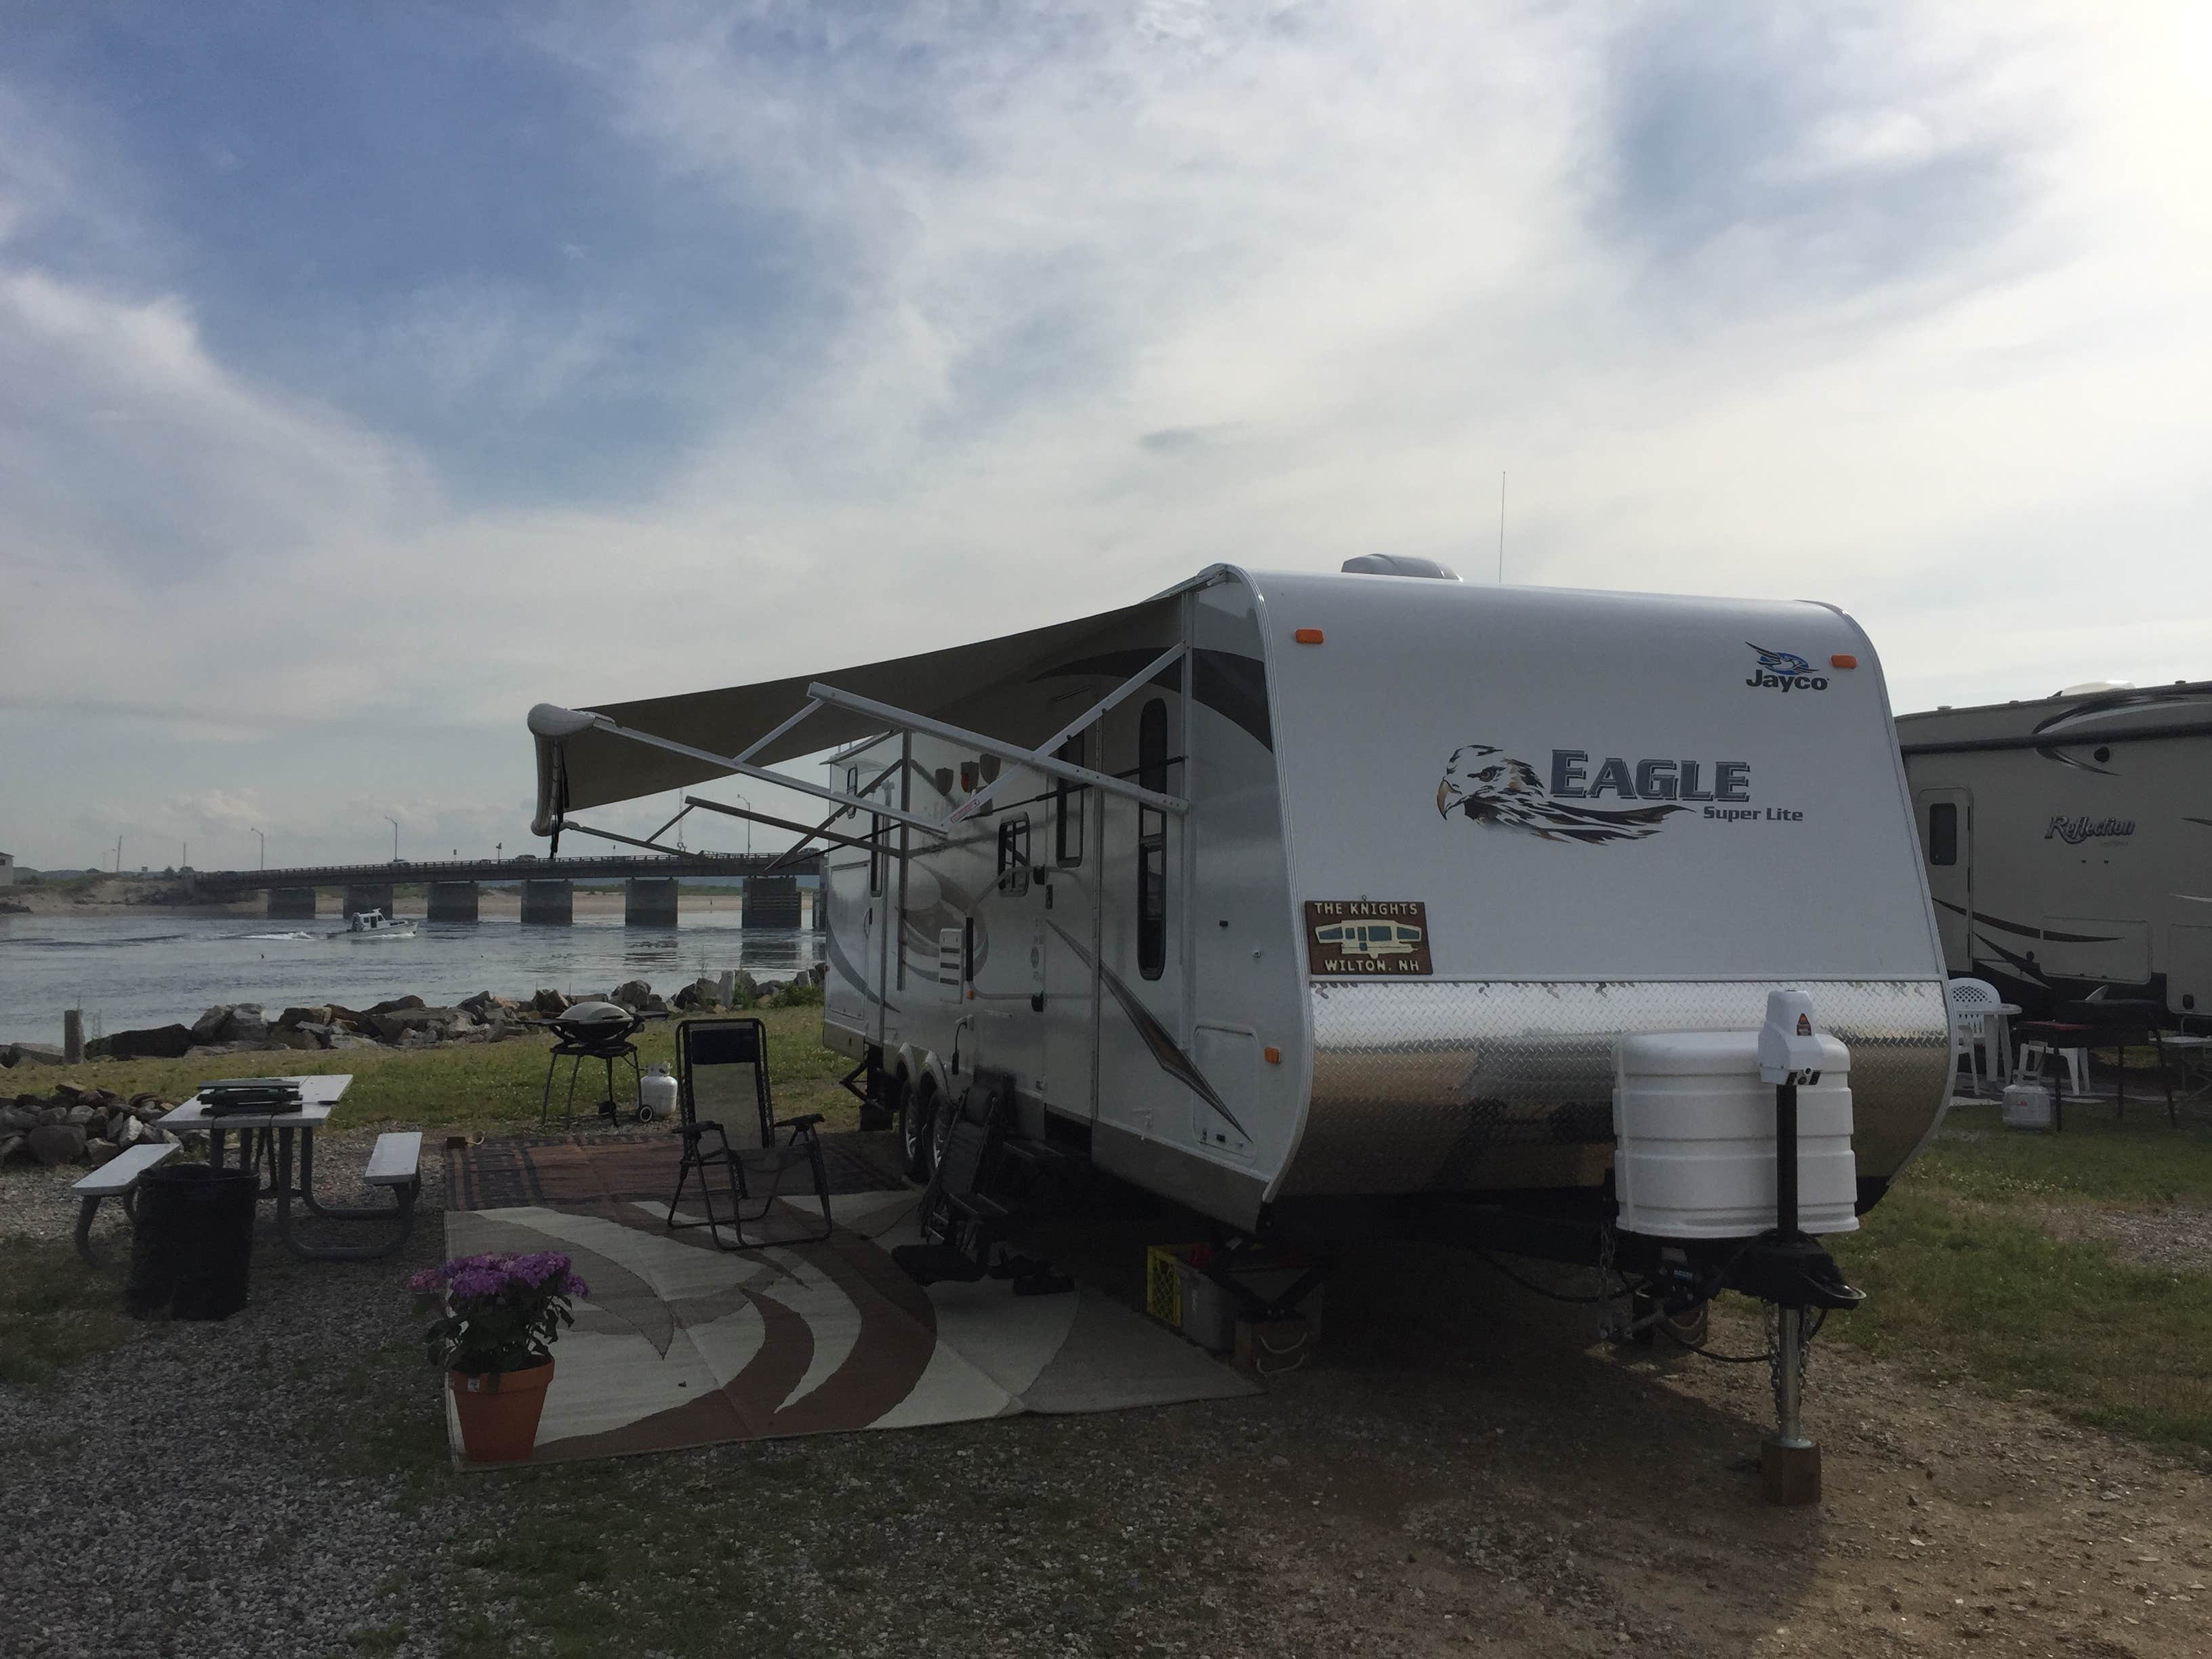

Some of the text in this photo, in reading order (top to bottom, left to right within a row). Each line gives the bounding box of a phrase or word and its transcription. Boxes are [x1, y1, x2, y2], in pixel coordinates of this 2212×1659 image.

[1746, 670, 1828, 692] Jayco
[1550, 749, 1750, 802] EAGLE
[1703, 806, 1803, 822] Super Lite
[2044, 815, 2135, 844] Reflection
[1314, 902, 1418, 916] THE KNIGHTS
[1398, 959, 1420, 972] NH
